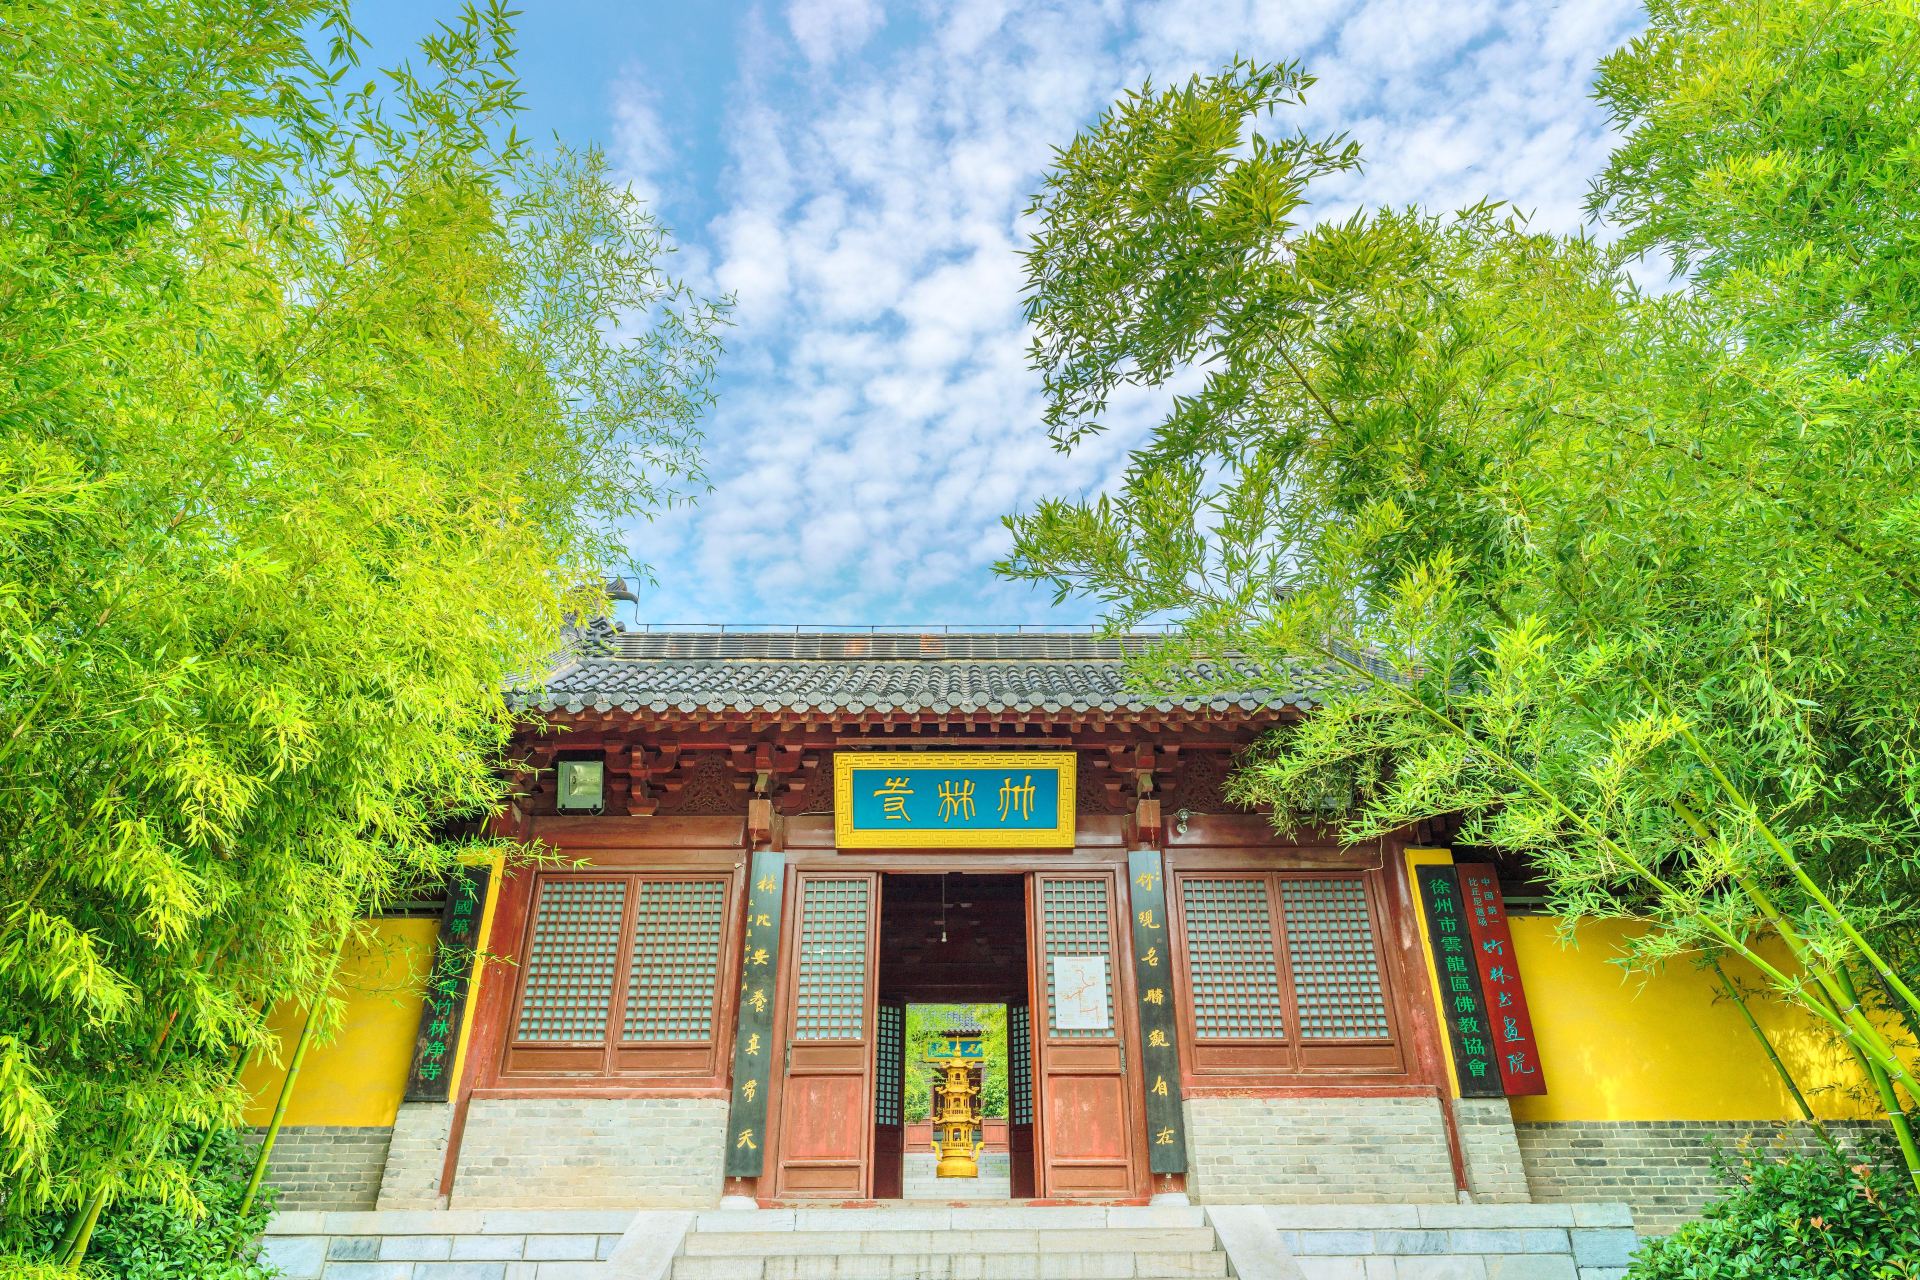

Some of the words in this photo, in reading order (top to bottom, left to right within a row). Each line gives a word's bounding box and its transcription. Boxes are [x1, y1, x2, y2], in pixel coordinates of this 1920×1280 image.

[1428, 879, 1488, 1077] 徐州市雲龍區佛教協會
